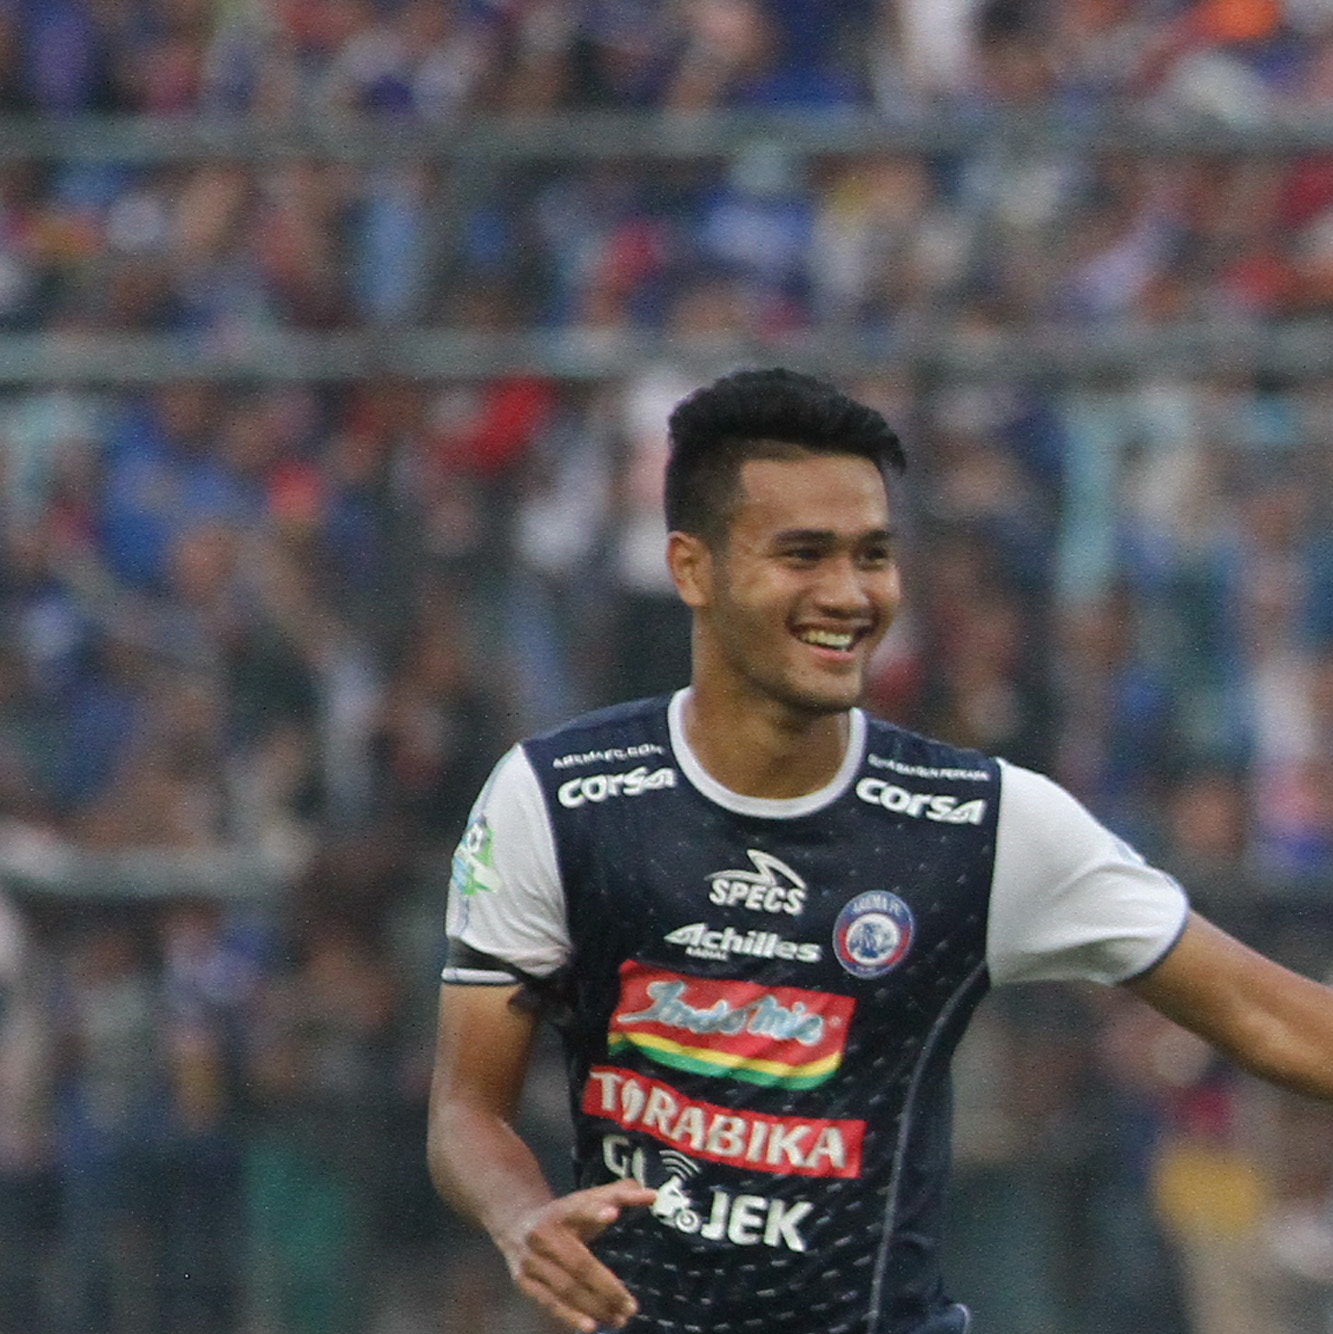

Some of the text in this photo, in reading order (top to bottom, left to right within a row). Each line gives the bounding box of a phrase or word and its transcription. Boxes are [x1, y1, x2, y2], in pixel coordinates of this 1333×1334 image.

[708, 878, 808, 917] SPECS
[663, 922, 824, 964] Achilles
[589, 1070, 848, 1171] TORABIKA
